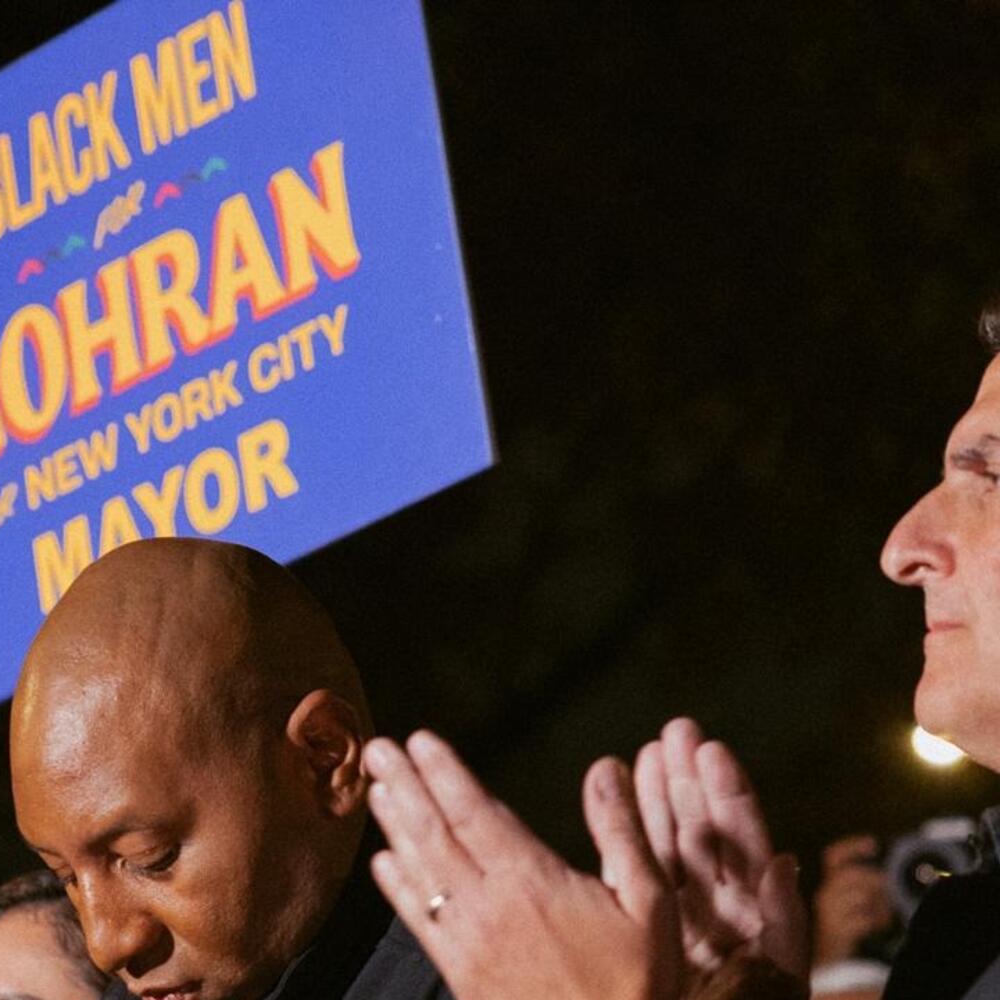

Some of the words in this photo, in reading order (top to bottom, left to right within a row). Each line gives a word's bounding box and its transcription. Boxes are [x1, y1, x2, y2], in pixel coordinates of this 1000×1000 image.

[130, 0, 257, 154] MEN
[24, 422, 118, 510] NEW
[126, 361, 244, 455] YORK
[248, 304, 348, 393] CITY
[32, 418, 299, 615] MAYOR
